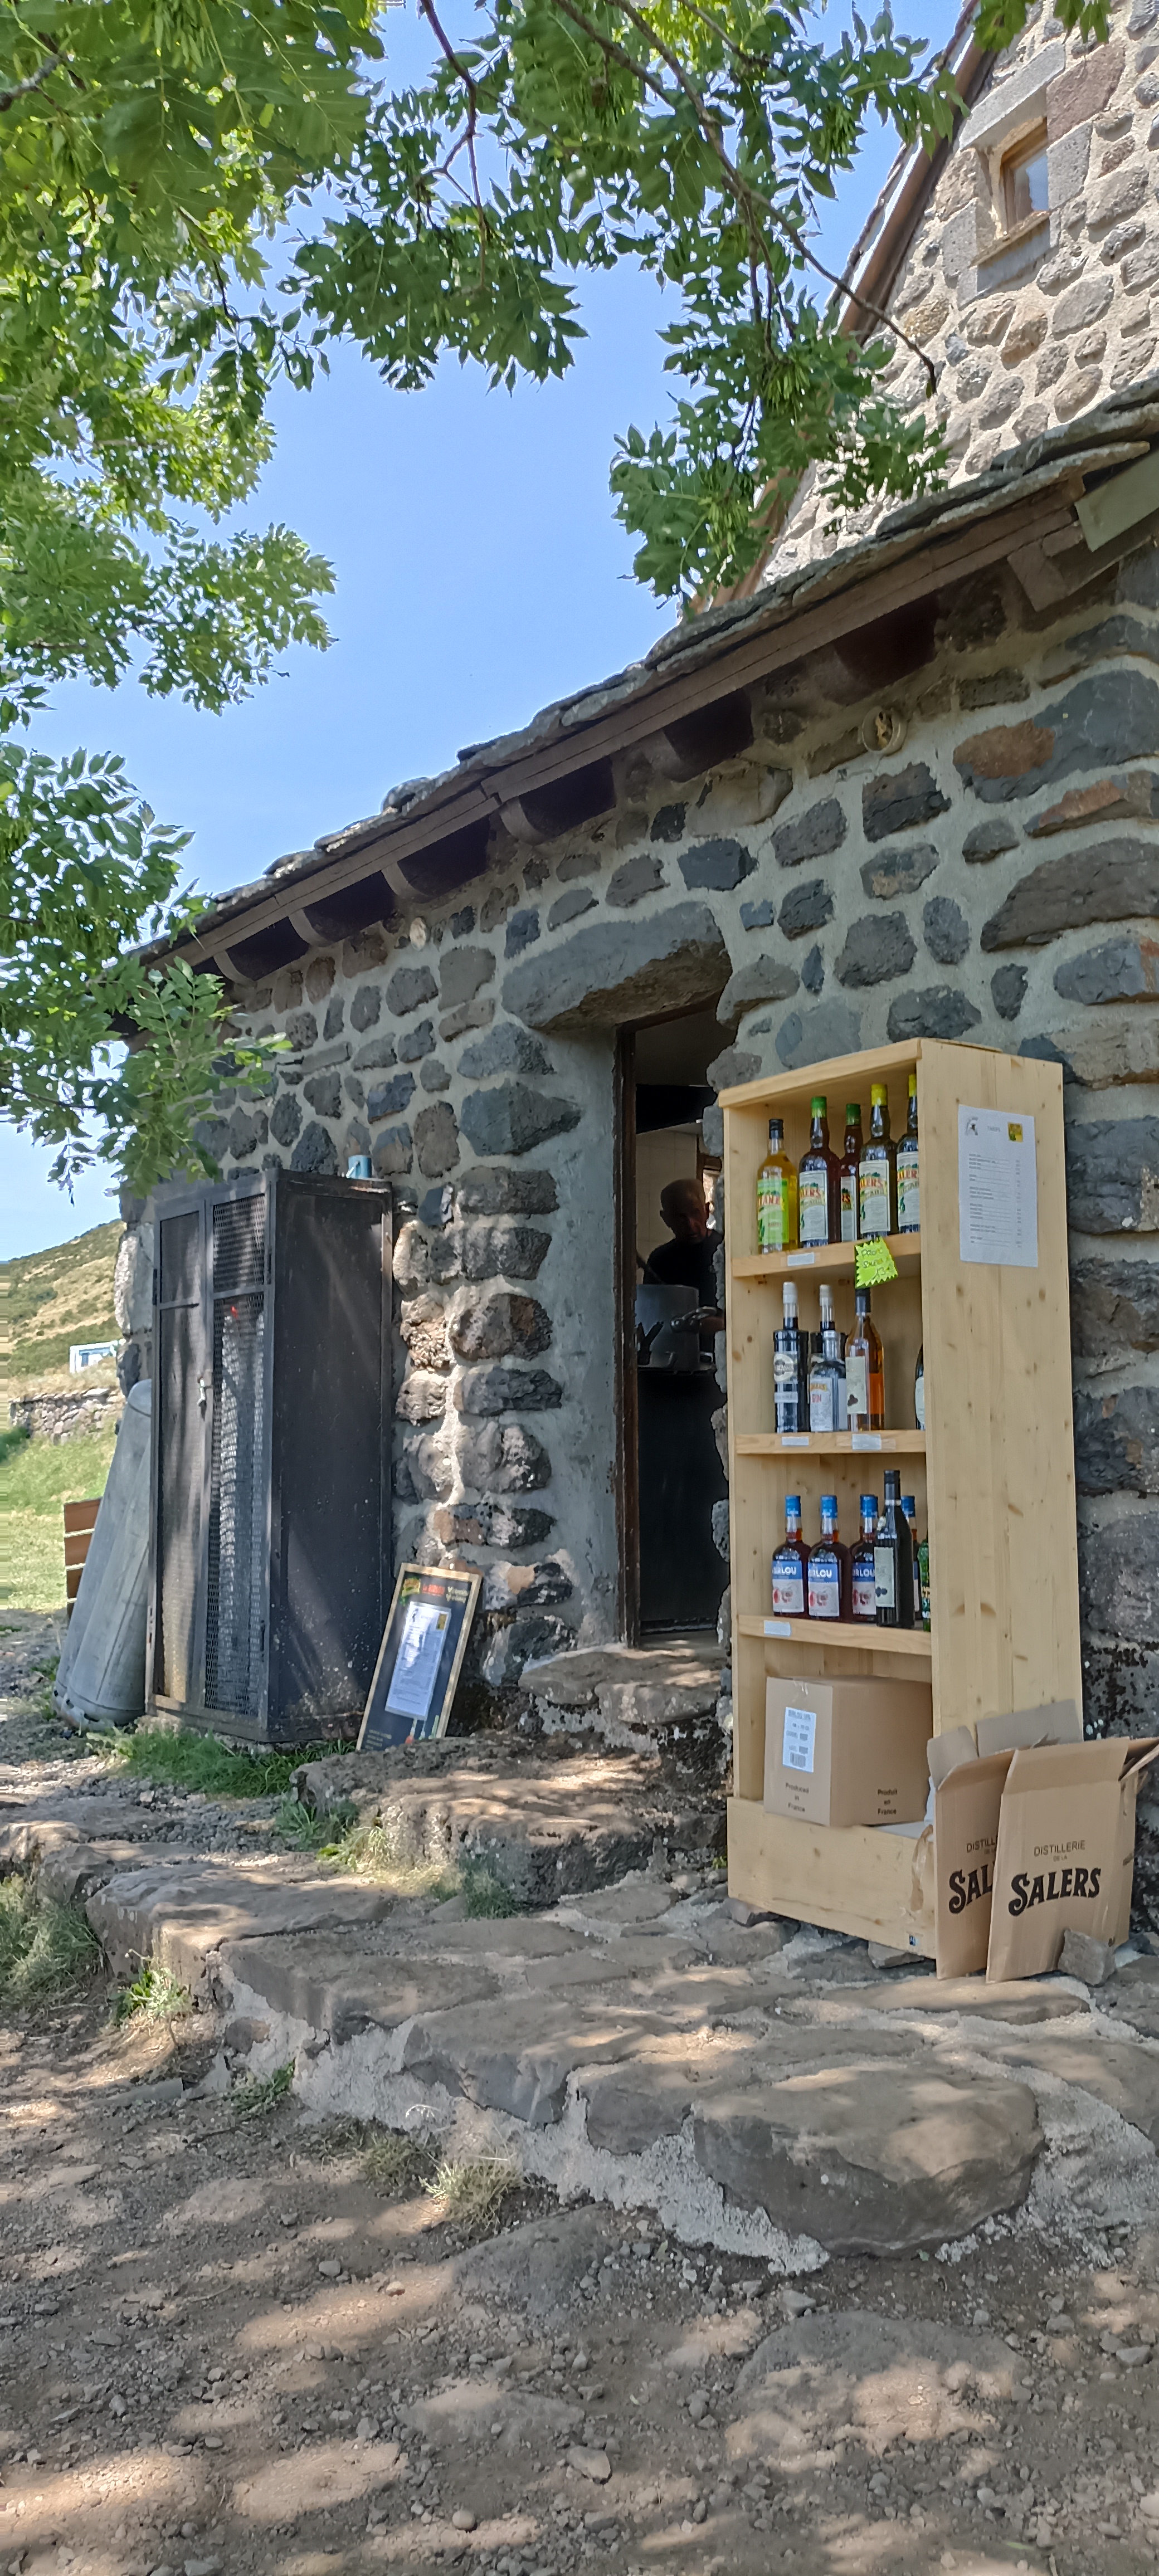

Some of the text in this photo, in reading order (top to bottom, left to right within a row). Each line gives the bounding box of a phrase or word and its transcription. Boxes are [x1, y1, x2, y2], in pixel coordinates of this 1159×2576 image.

[811, 1393, 822, 1403] GIN
[785, 1782, 809, 1794] Produced
[877, 1788, 898, 1796] Produit
[788, 1802, 806, 1812] France
[877, 1807, 897, 1816] France
[966, 1836, 997, 1853] DISTILL
[1034, 1840, 1085, 1857] DISTILLERIE
[948, 1861, 995, 1914] SAL
[1007, 1867, 1102, 1917] SALERS
